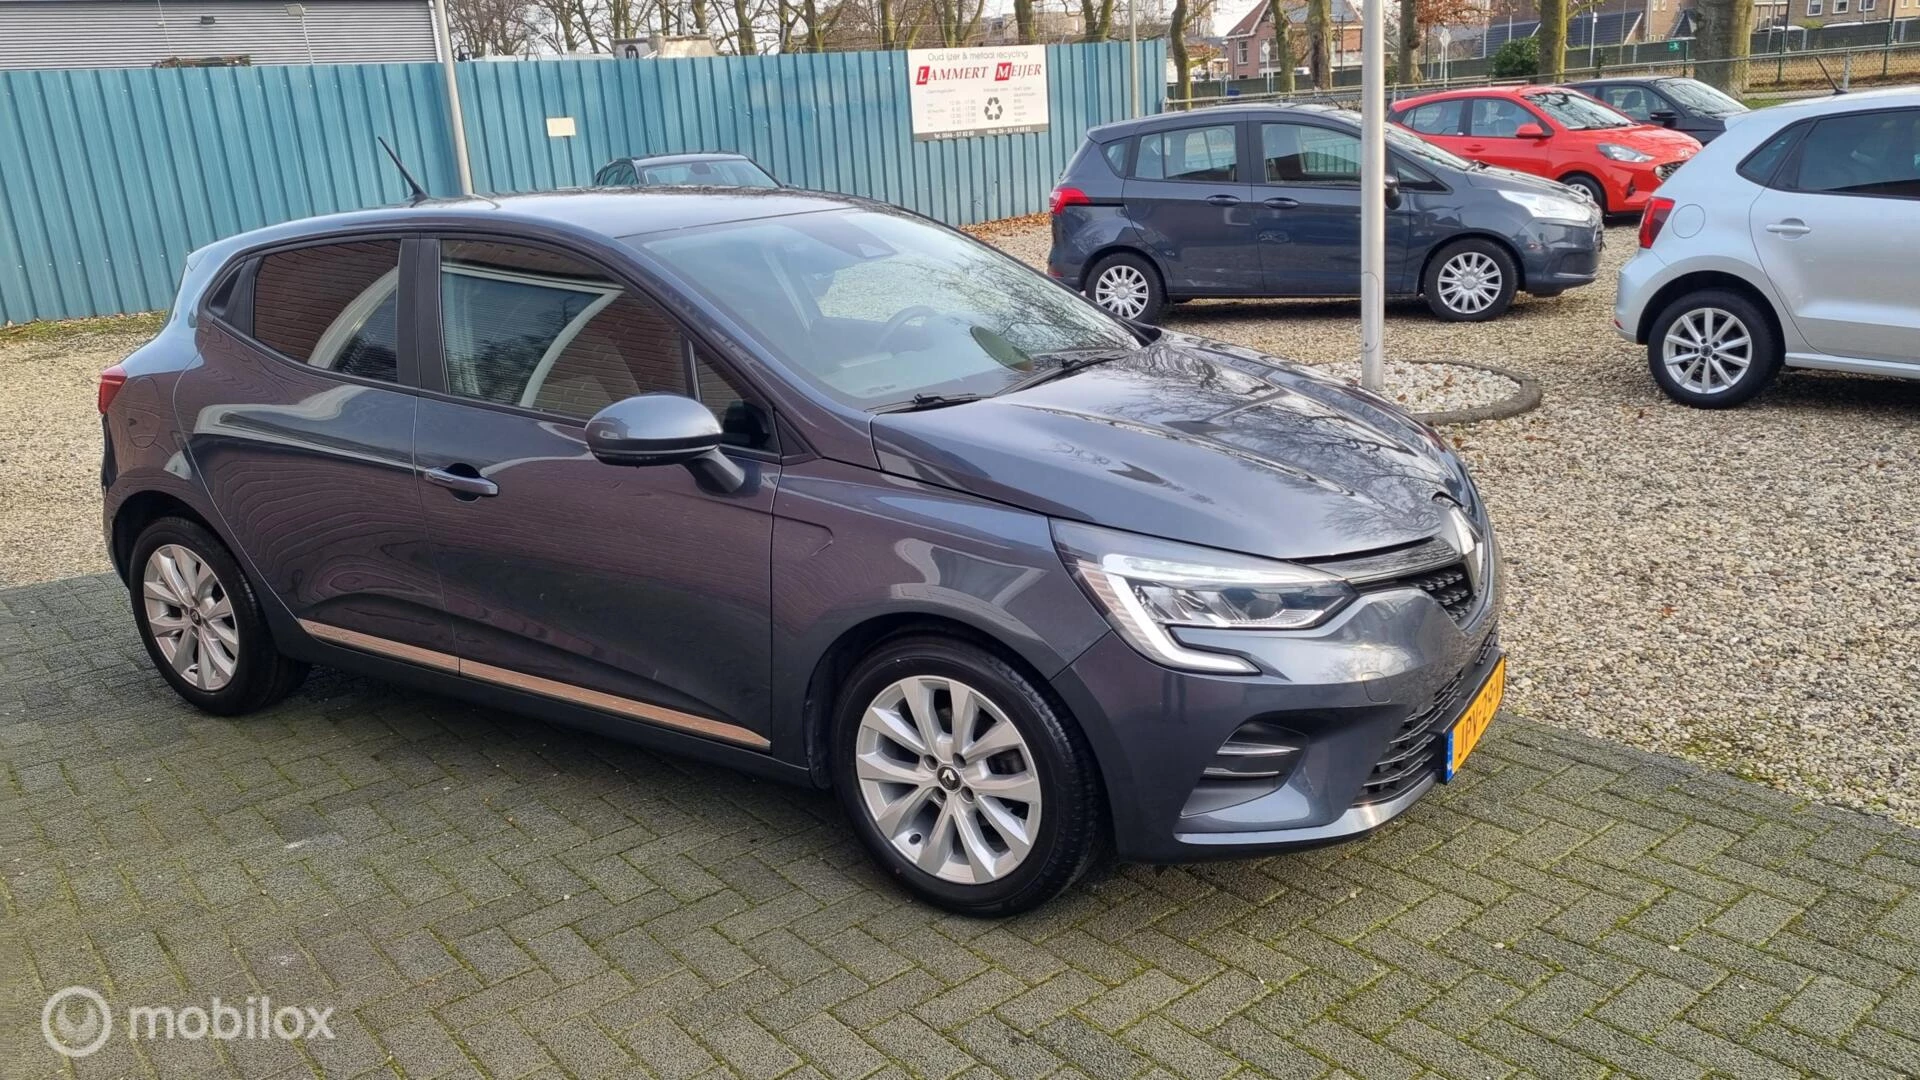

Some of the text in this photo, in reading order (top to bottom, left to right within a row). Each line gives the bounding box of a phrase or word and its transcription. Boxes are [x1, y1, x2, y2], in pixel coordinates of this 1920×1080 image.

[928, 53, 944, 61] Oud
[962, 52, 968, 60] &
[970, 51, 995, 60] metaal
[997, 50, 1029, 60] recycling
[917, 62, 1042, 85] LAMMERT MEIJER
